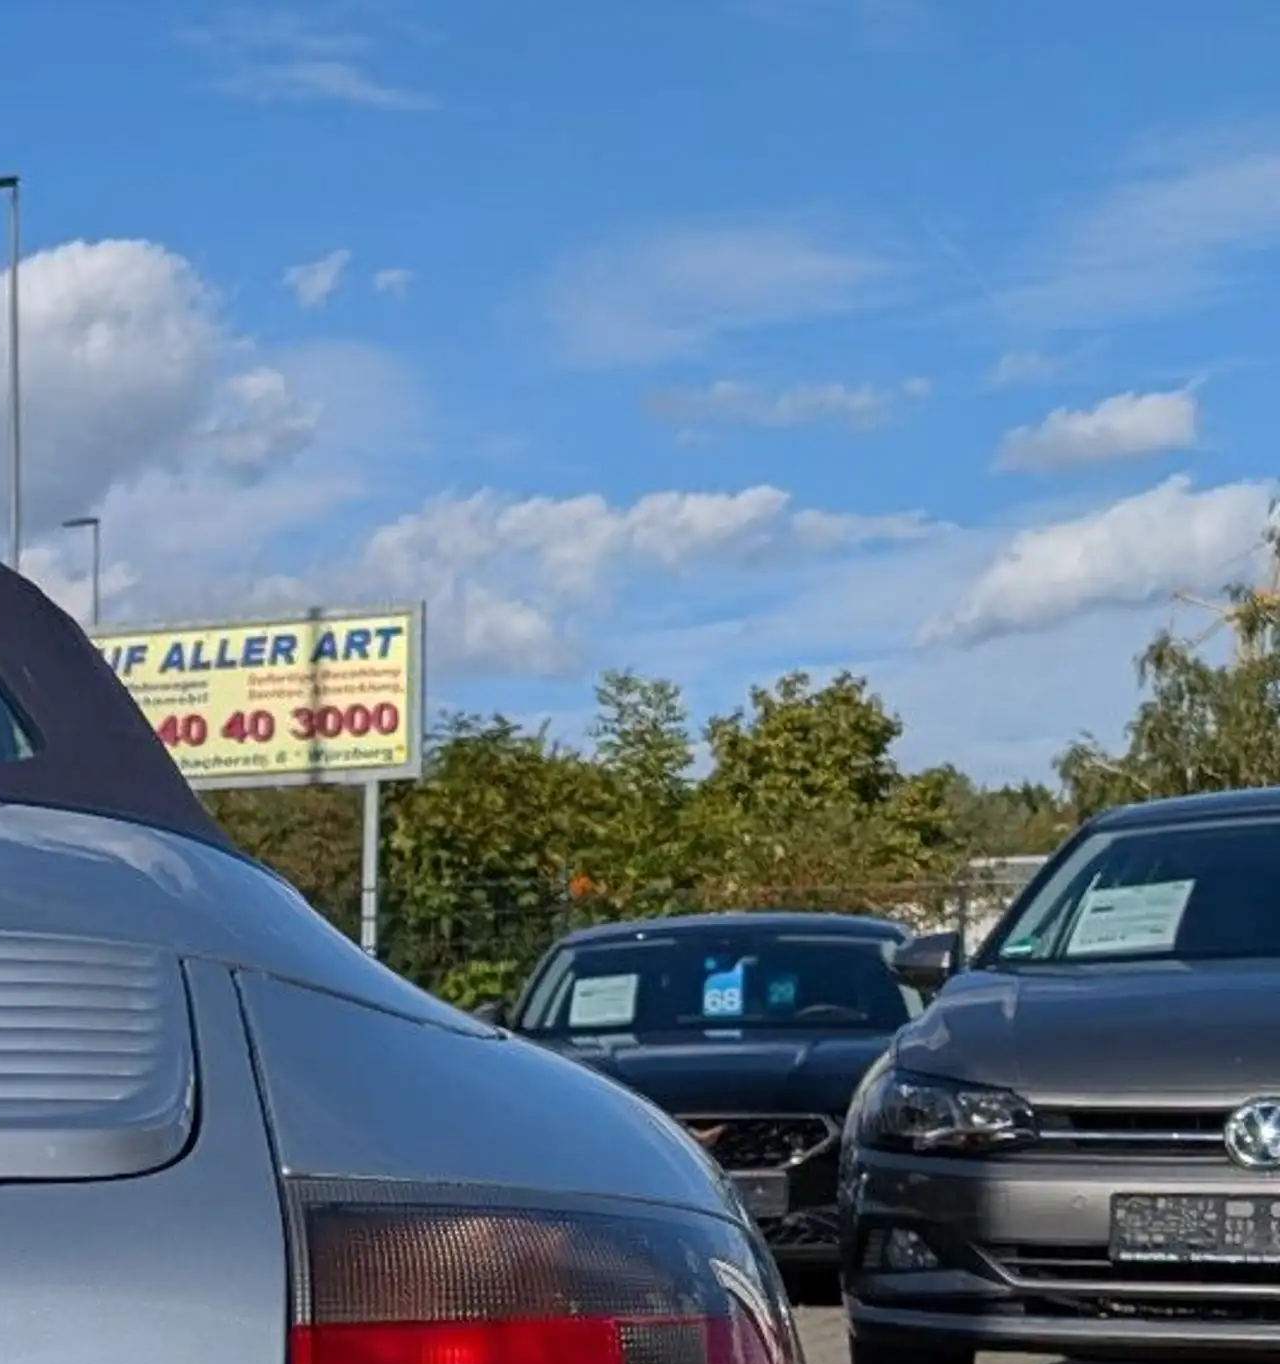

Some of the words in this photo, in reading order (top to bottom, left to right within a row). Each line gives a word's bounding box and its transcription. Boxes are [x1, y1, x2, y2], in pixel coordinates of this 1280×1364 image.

[158, 633, 297, 674] ALLER
[311, 626, 402, 662] ART
[156, 714, 207, 747] 40
[221, 710, 274, 743] 40
[290, 702, 399, 740] 3000
